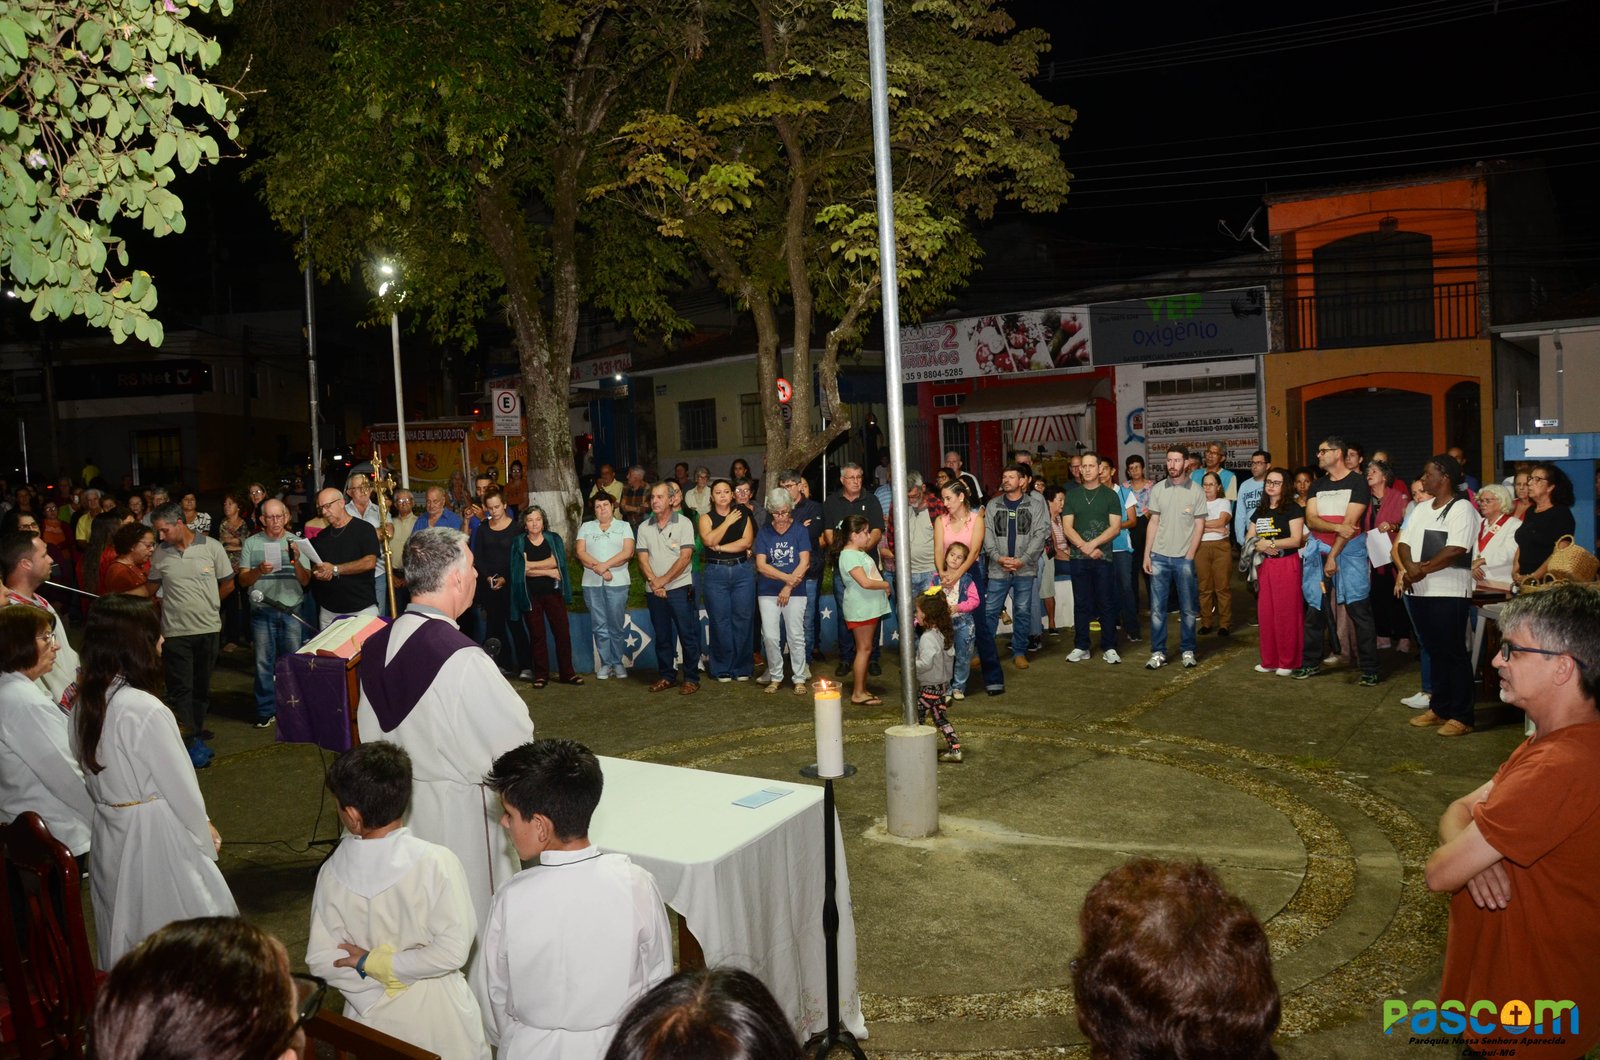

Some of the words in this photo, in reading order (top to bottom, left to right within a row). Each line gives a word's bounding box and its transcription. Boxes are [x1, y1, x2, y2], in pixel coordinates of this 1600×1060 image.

[1146, 293, 1202, 321] YEP
[942, 323, 960, 350] 2
[1132, 322, 1218, 347] oxigênio
[905, 372, 916, 381] 35
[923, 368, 964, 379] 8804-5285
[503, 397, 510, 409] E
[775, 541, 788, 549] PAZ
